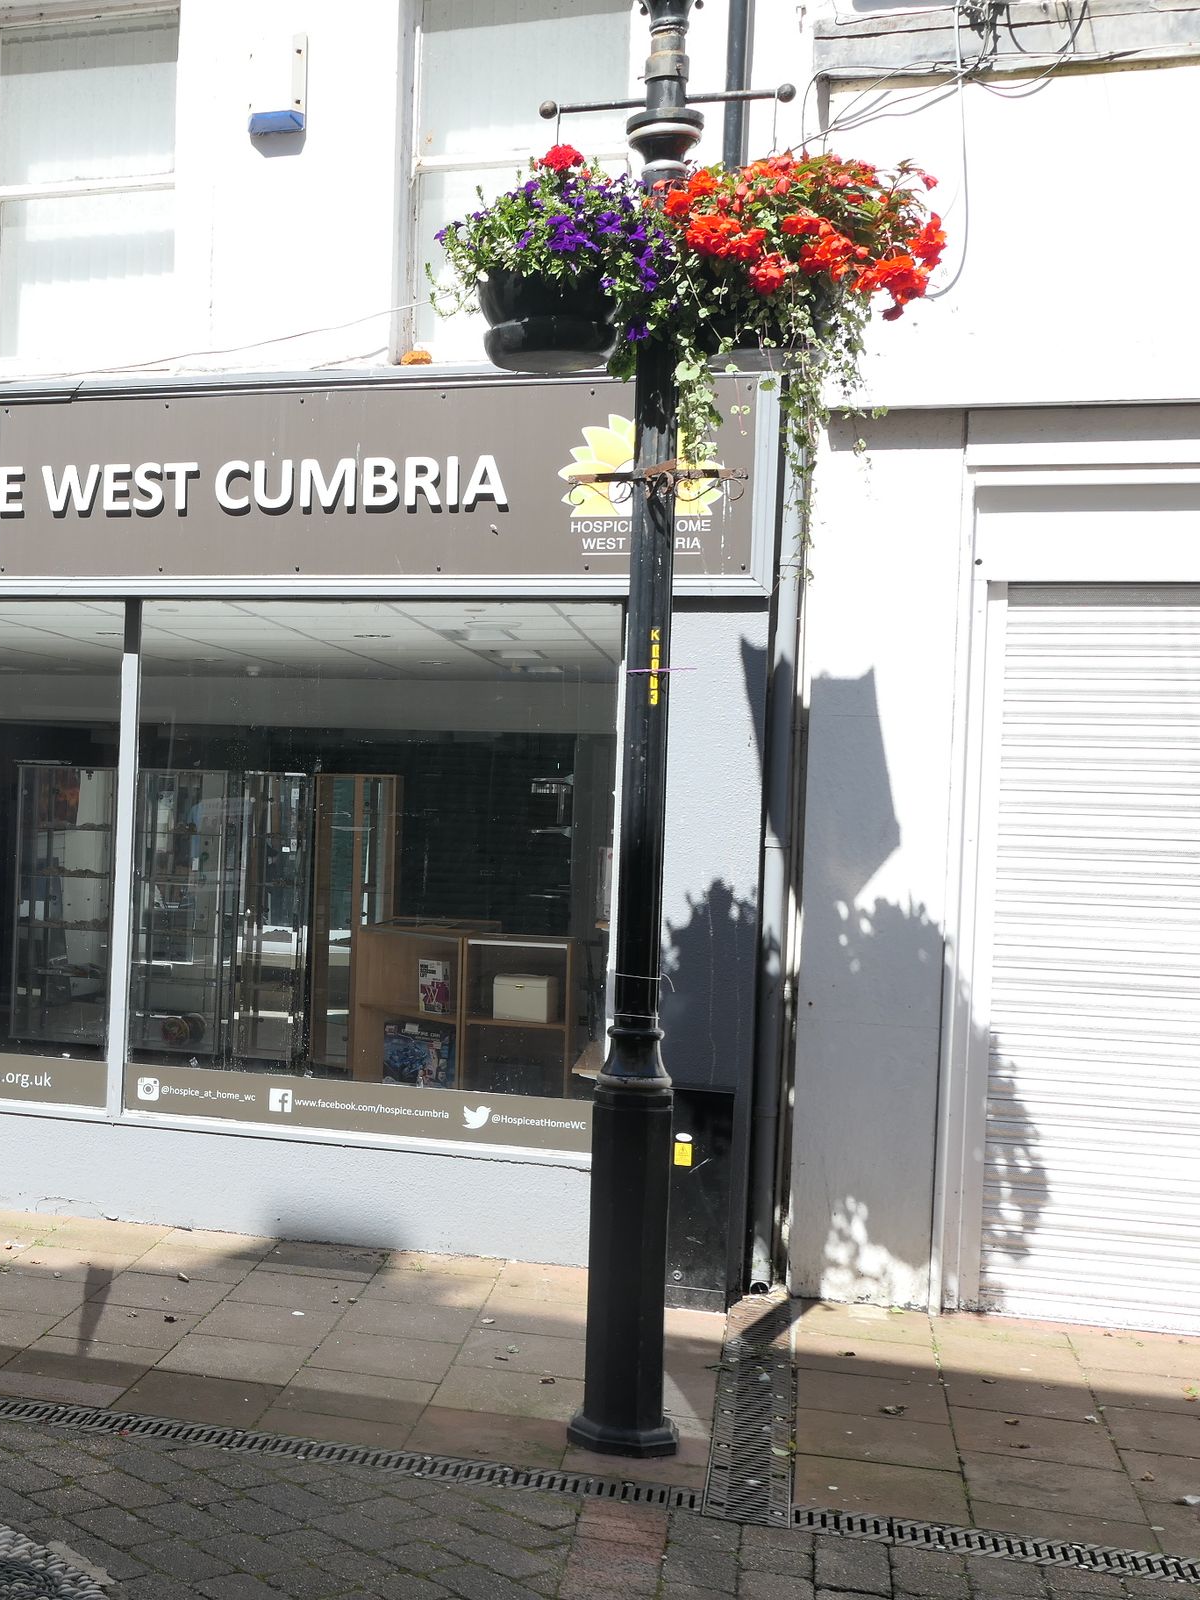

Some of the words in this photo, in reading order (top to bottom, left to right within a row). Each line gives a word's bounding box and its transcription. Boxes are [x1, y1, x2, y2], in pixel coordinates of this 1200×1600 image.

[42, 462, 198, 513] WEST
[215, 455, 508, 511] CUMBRIA
[676, 520, 712, 532] OME
[582, 537, 626, 550] WEST
[161, 1086, 256, 1102] @hospice_at_home_wc
[294, 1098, 449, 1119] www.facebook.com/hospice.cumbria
[491, 1114, 586, 1130] @HospiceatHomeWC
